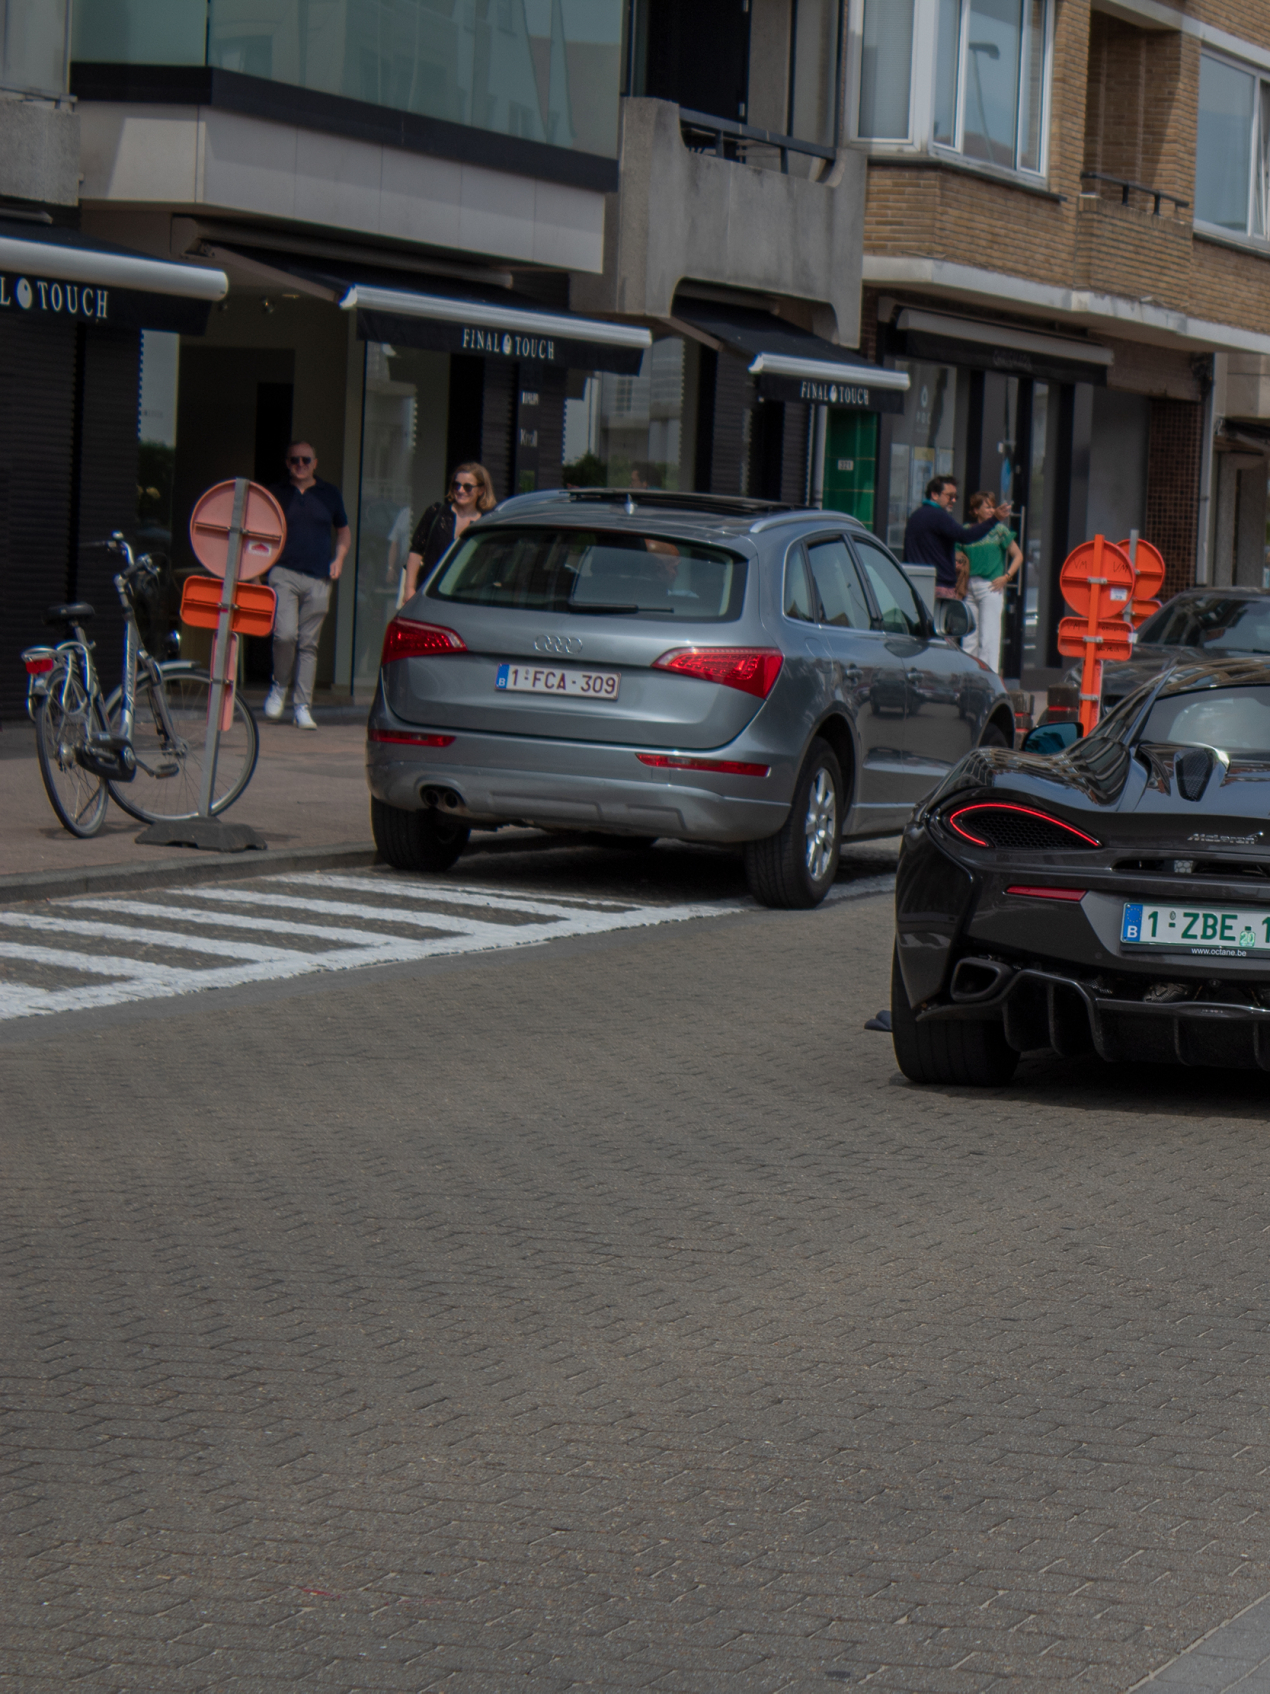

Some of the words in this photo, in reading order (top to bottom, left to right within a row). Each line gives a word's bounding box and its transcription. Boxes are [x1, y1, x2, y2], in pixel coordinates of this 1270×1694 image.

[37, 280, 109, 318] TOUCH
[463, 327, 500, 353] FINAL
[515, 336, 555, 360] TOUCH
[801, 380, 829, 401] FINAL
[839, 386, 870, 406] TOUCH
[498, 677, 506, 687] B
[1127, 925, 1138, 939] B
[1240, 931, 1255, 945] 20
[1191, 946, 1247, 958] www.octane.be
